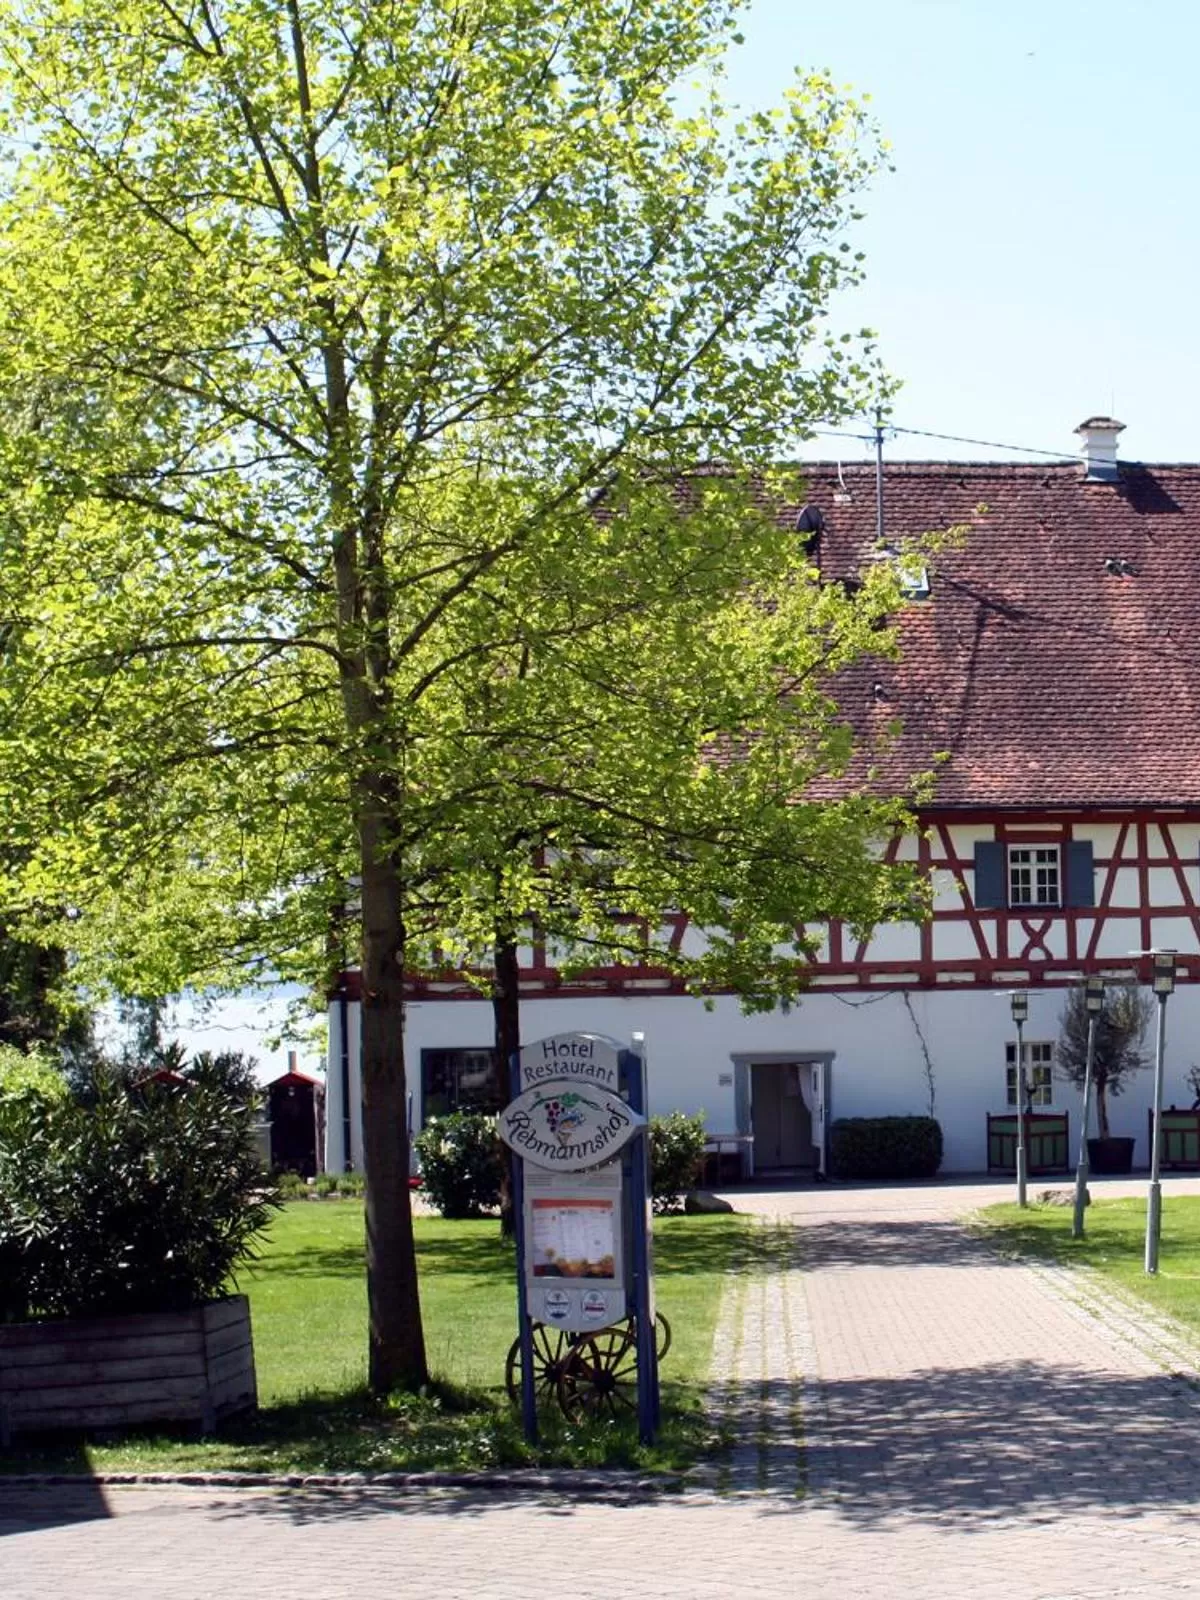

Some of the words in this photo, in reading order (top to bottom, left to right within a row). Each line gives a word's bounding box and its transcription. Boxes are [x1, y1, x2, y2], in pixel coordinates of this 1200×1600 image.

[542, 1040, 594, 1059] Hotel
[524, 1060, 615, 1083] Restaurant
[506, 1102, 629, 1160] Rebmannshof
